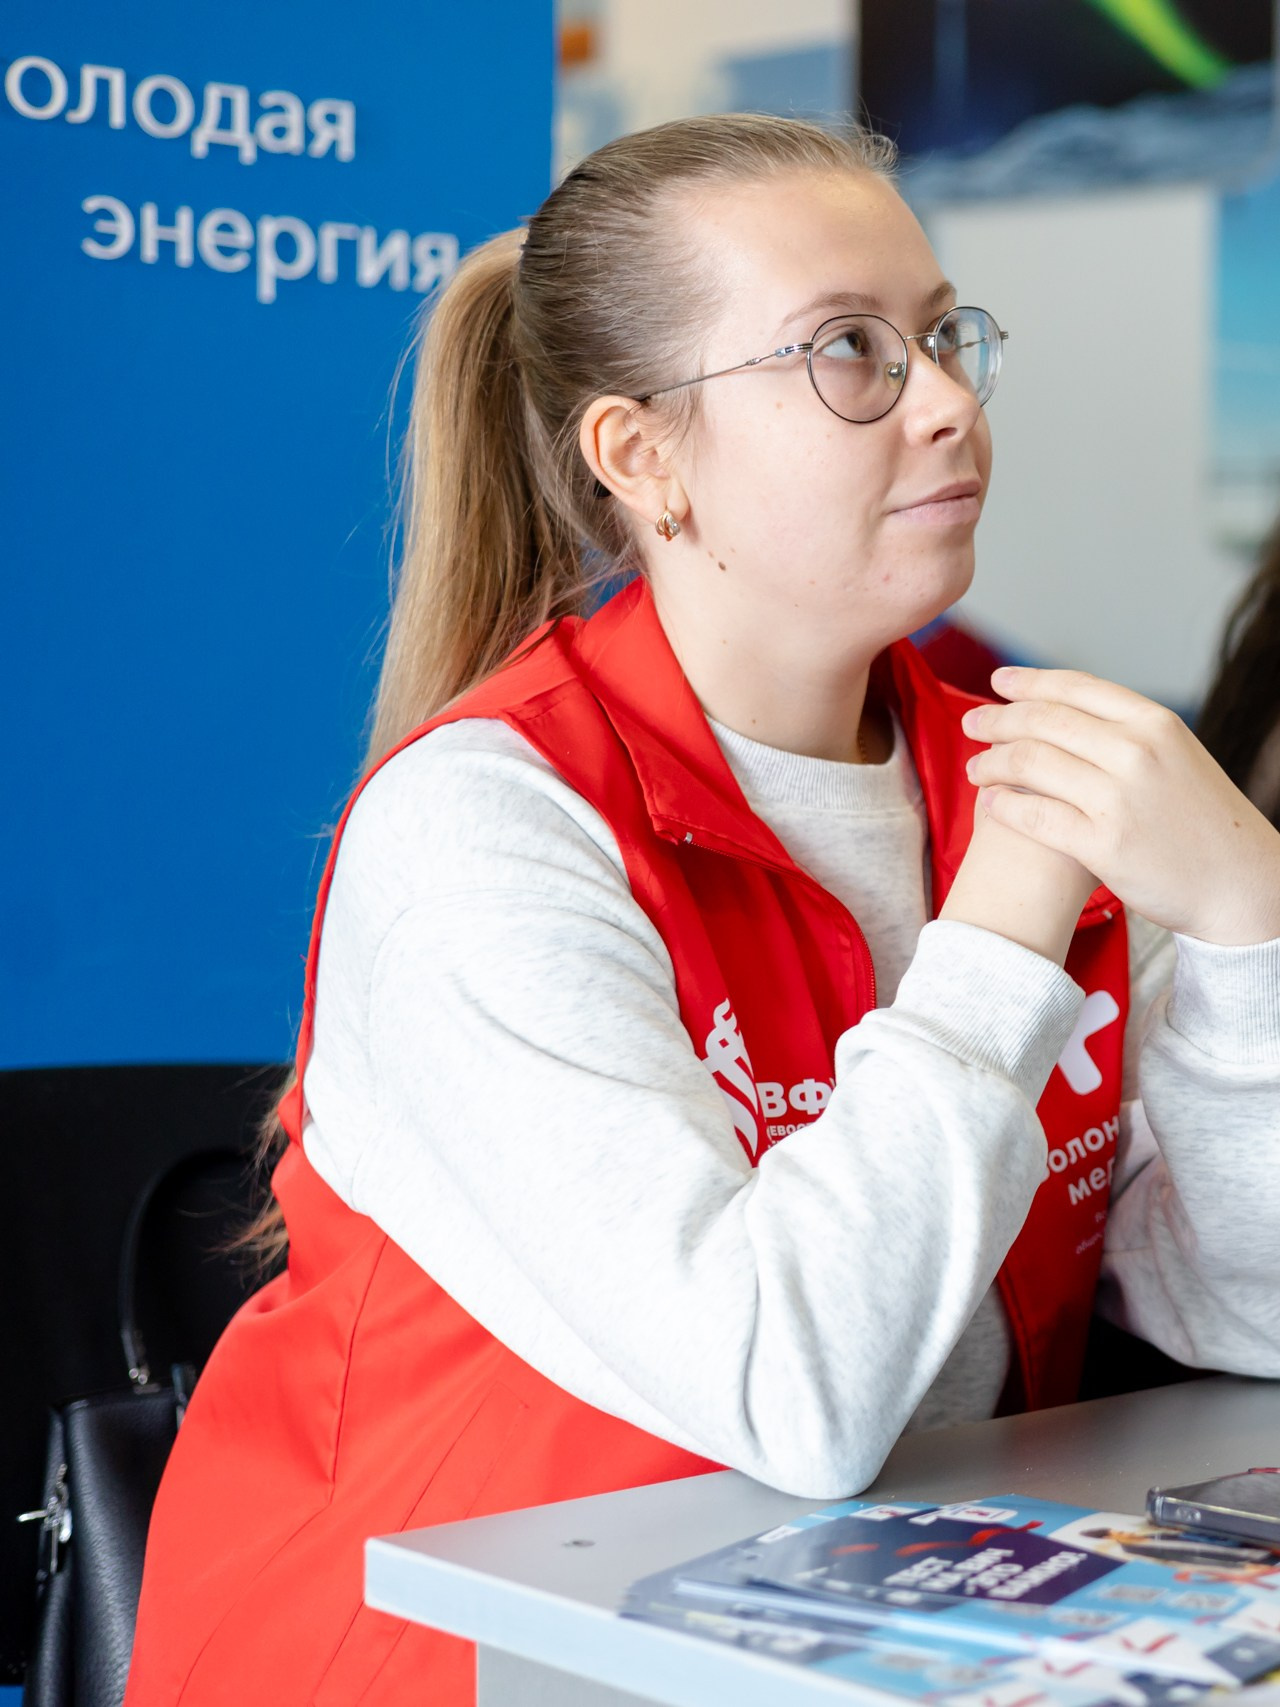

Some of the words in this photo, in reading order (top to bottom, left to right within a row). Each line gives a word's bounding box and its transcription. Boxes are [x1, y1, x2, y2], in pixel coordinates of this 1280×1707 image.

[4, 55, 357, 165] олодая
[81, 195, 461, 304] энергия
[755, 1078, 836, 1118] ВФ
[1048, 1115, 1119, 1174] олон
